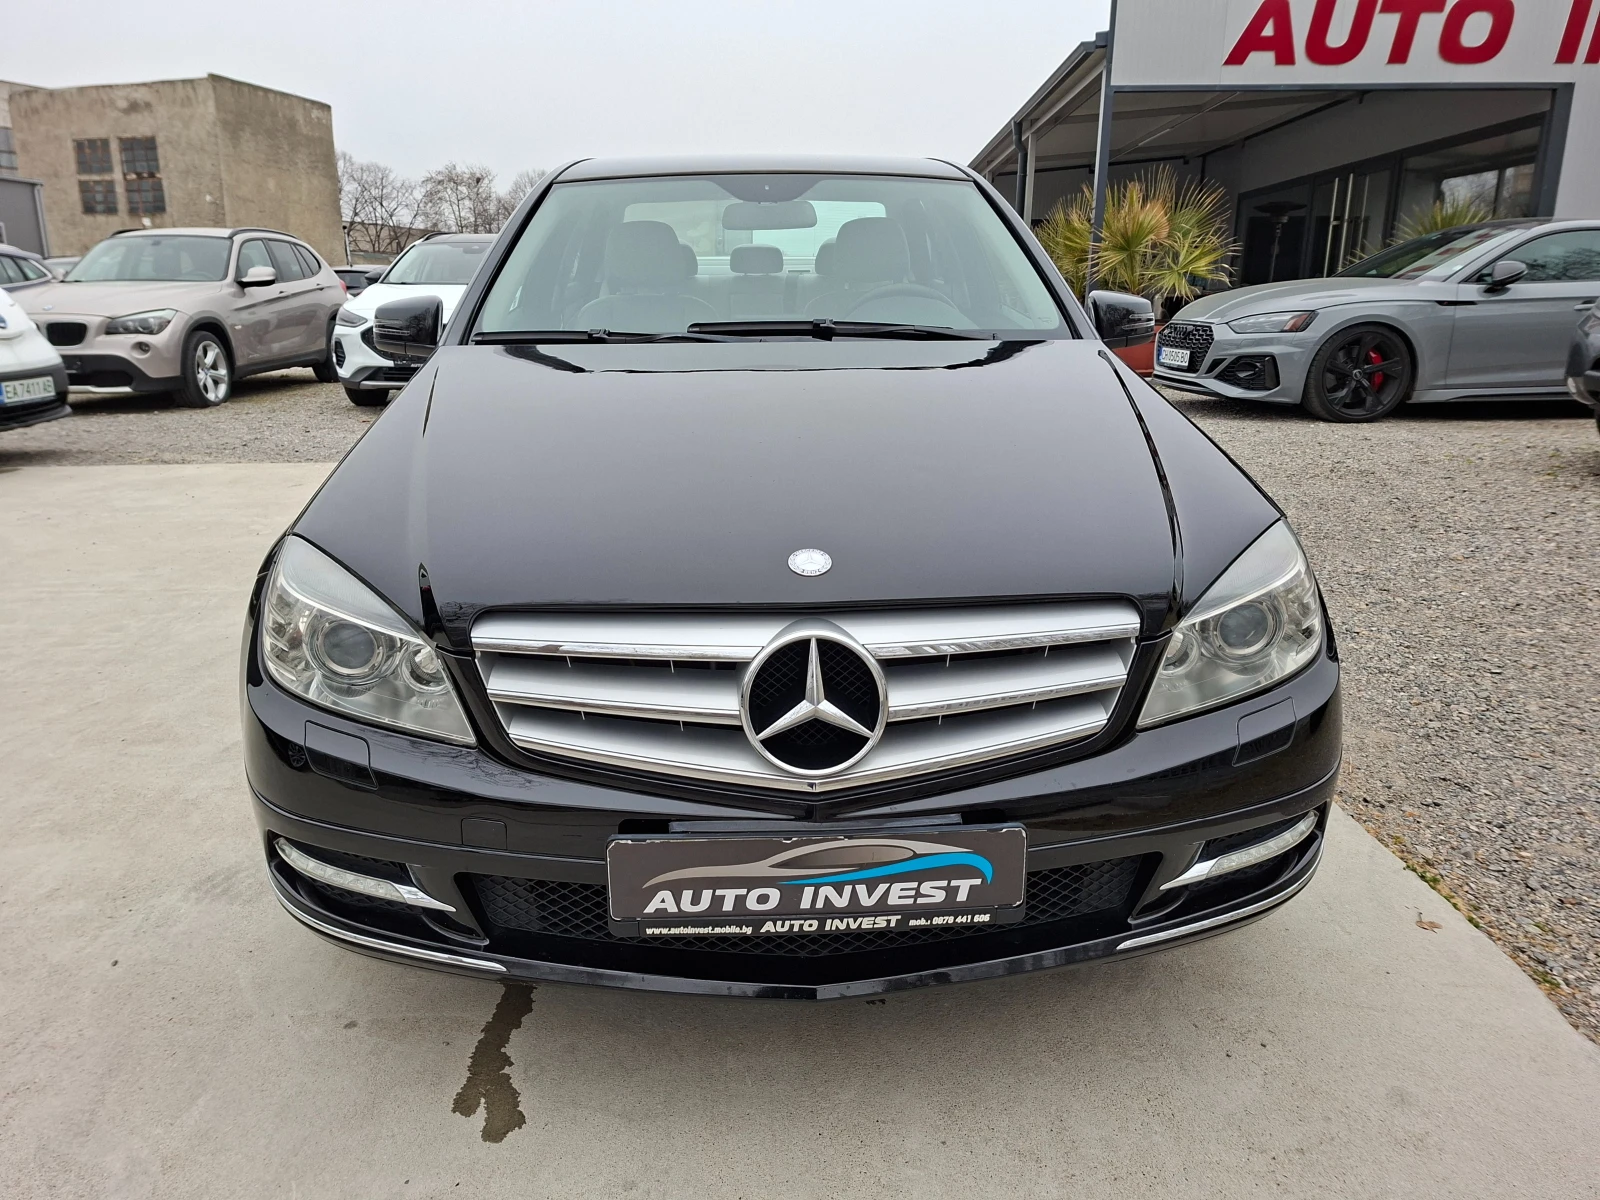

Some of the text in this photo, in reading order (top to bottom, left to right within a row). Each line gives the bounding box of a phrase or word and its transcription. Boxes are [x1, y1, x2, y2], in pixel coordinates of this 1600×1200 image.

[1222, 0, 1600, 66] AUTO I
[643, 878, 982, 913] AUTO INVEST
[645, 925, 753, 935] www.autoinvest.mobile.bg
[760, 919, 819, 933] AUTO
[824, 915, 901, 931] INVEST
[932, 915, 954, 925] 0878
[955, 914, 971, 923] 441
